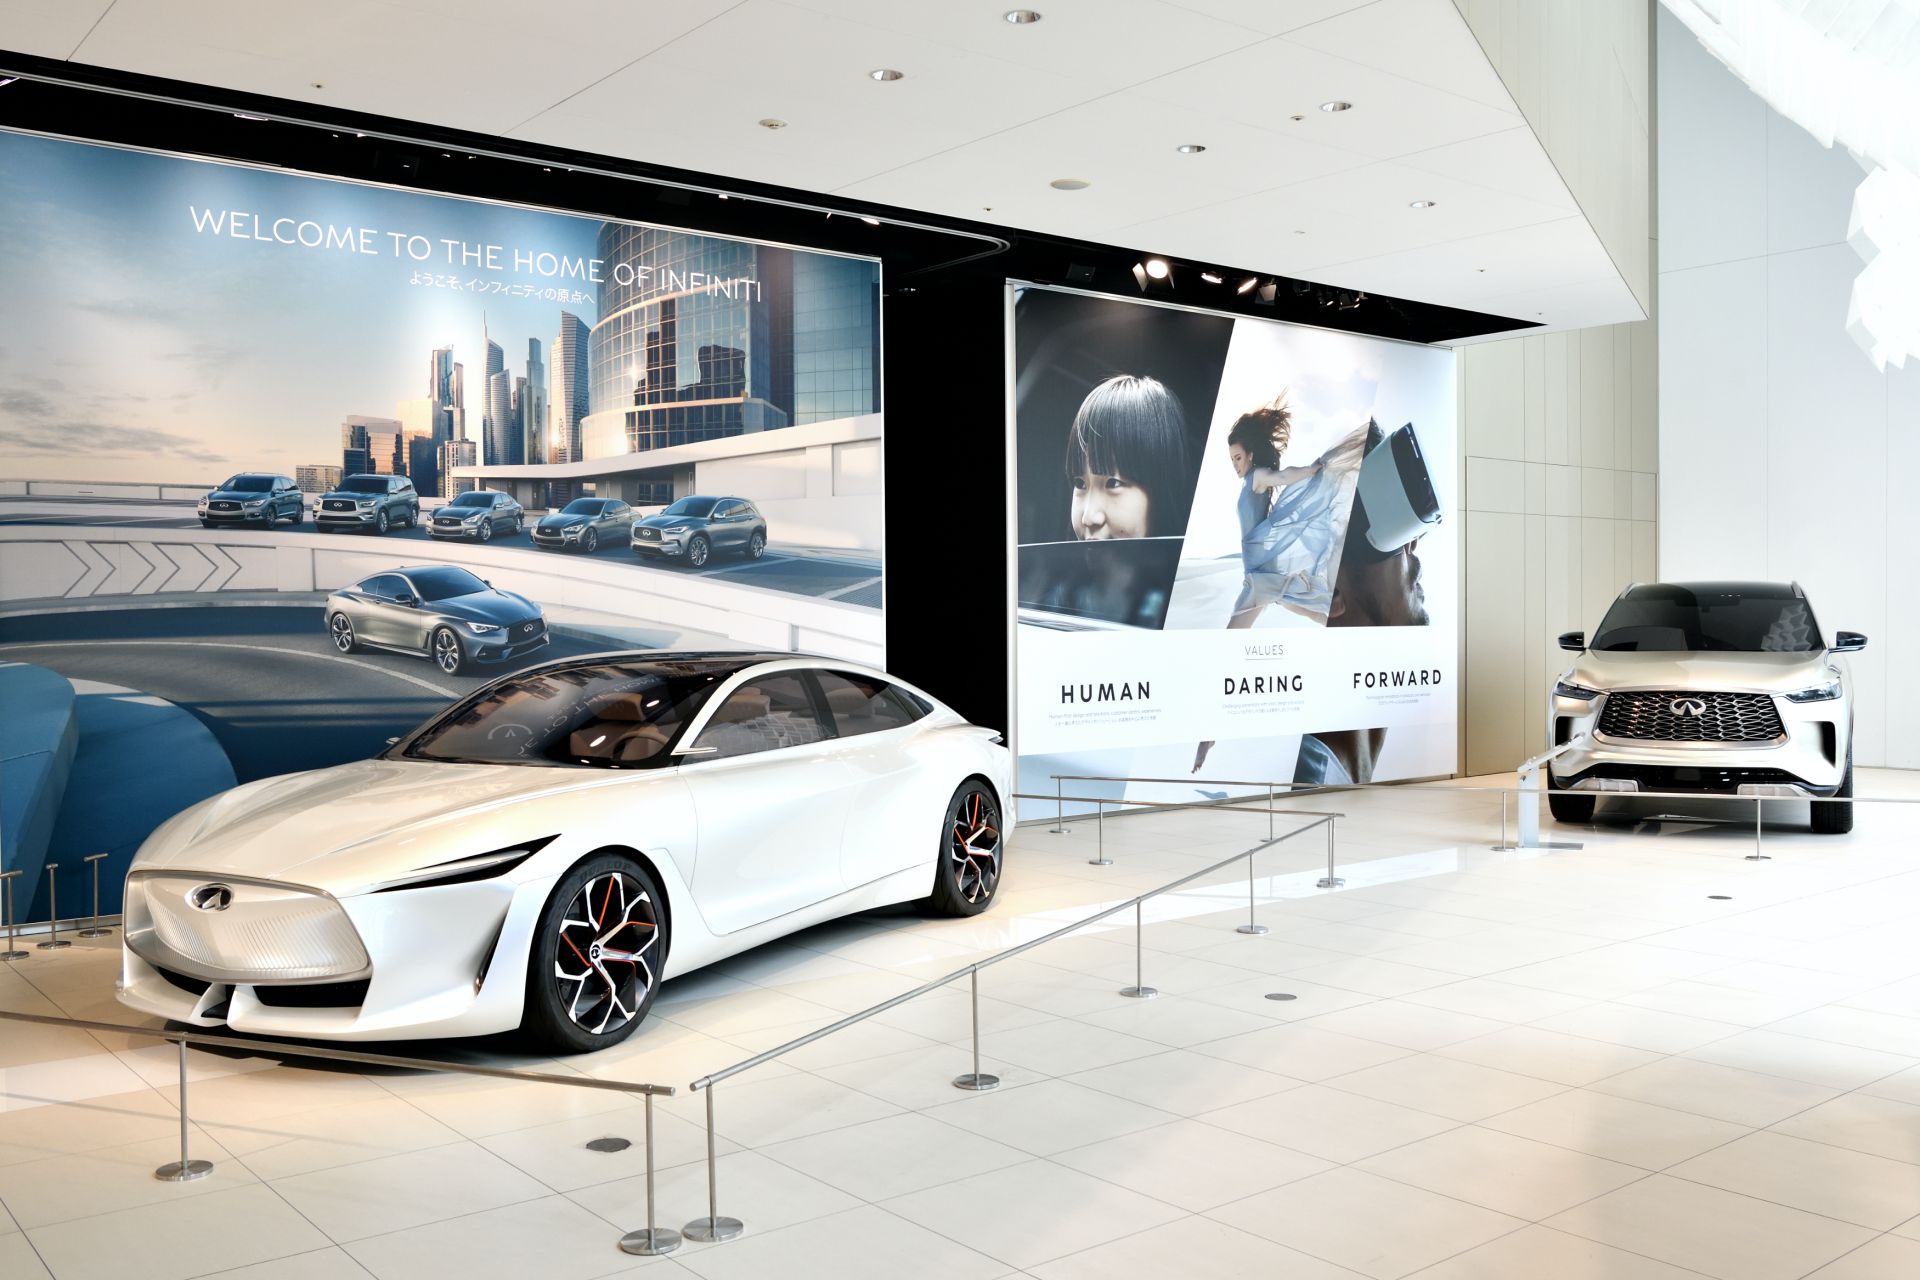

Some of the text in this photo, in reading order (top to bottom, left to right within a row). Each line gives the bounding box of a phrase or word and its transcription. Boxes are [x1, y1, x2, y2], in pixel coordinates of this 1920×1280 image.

[189, 205, 762, 303] WELCOME TO THE HOME OF INFINITI
[409, 271, 595, 304] ようこそ、インフィニティの原点へ
[1244, 644, 1284, 656] VALUES
[1224, 675, 1303, 696] DARING
[1353, 669, 1442, 689] FORWARD
[1061, 681, 1151, 704] HUMAN
